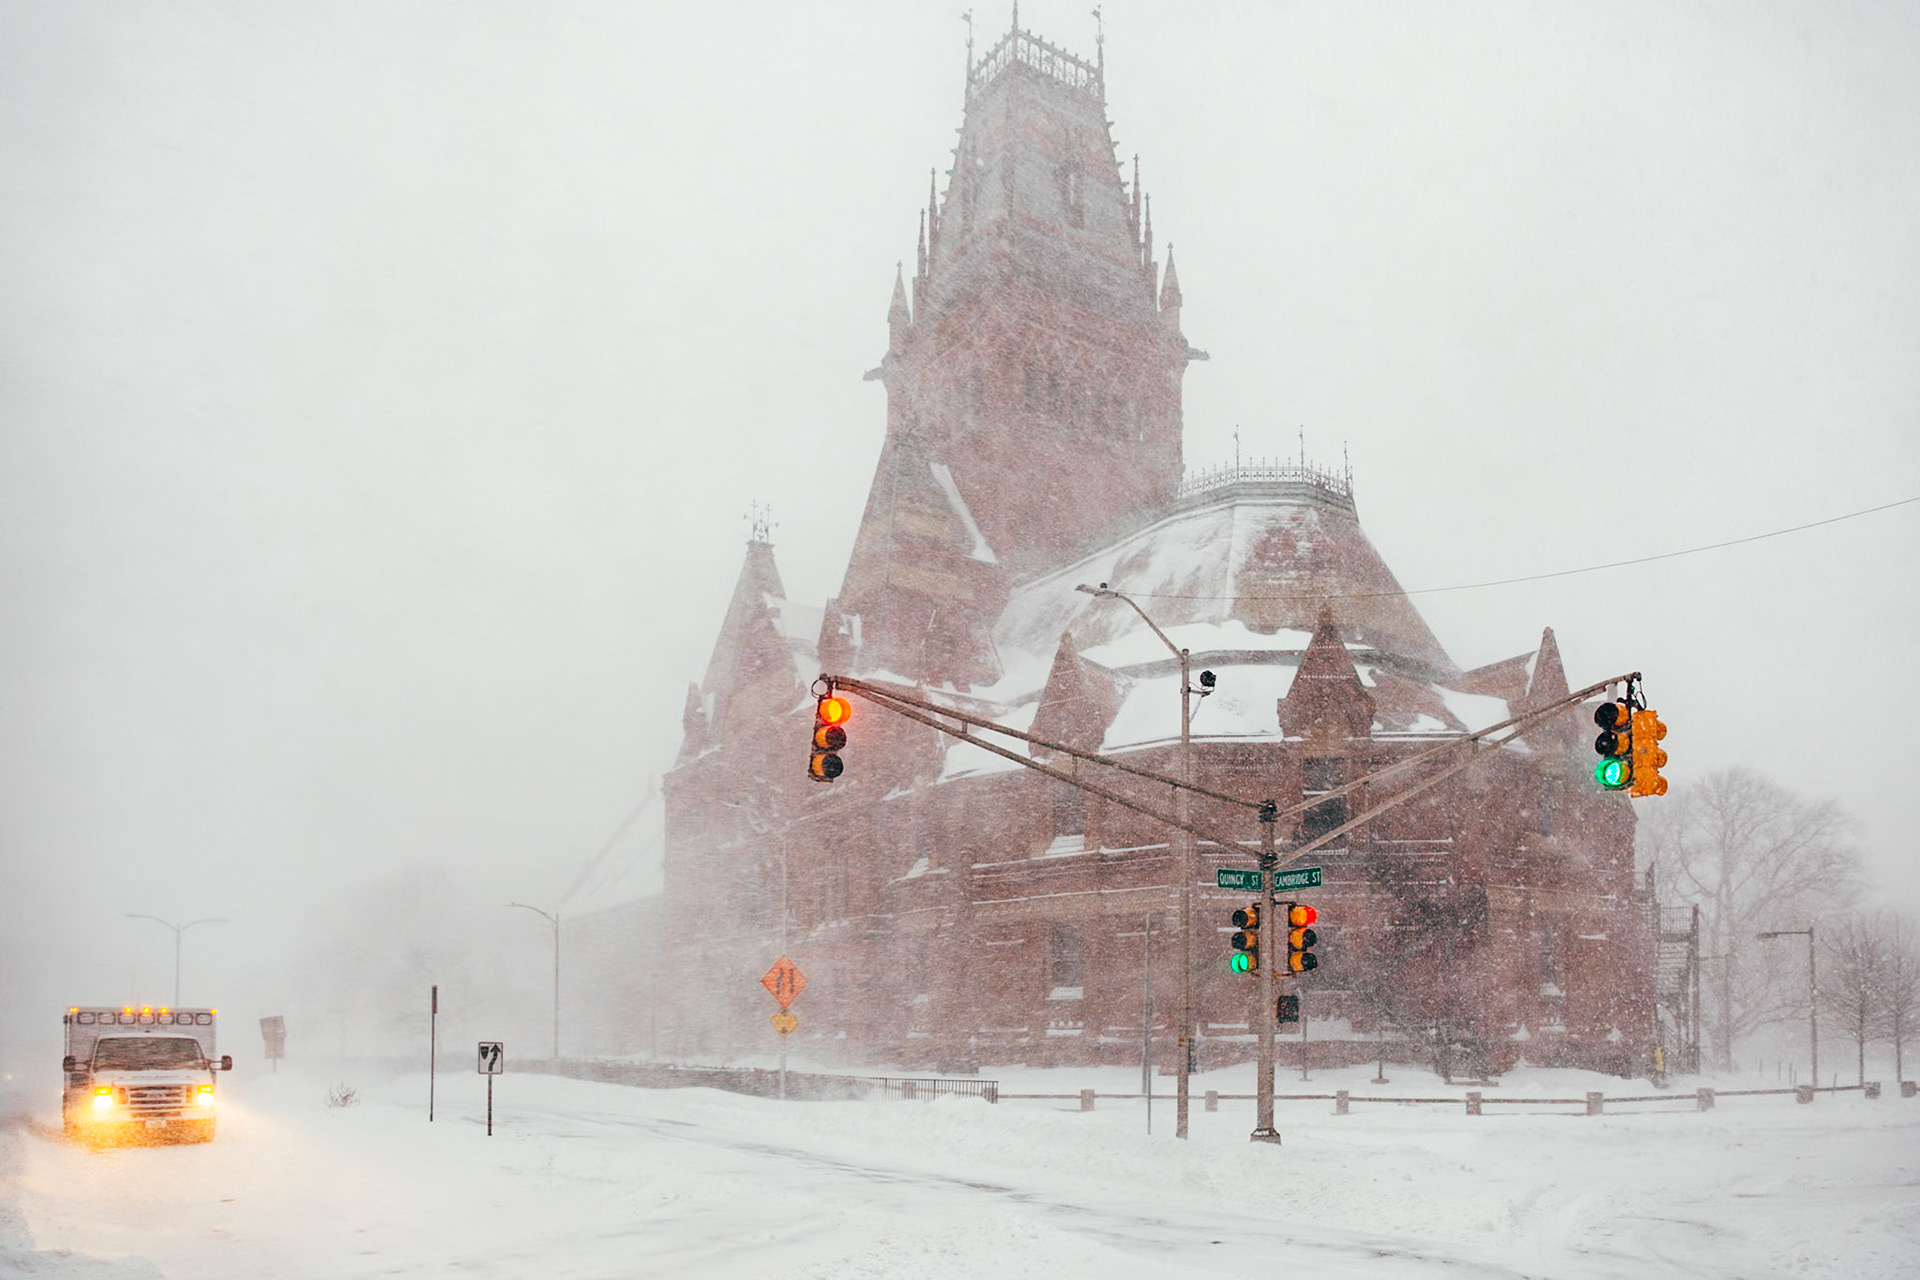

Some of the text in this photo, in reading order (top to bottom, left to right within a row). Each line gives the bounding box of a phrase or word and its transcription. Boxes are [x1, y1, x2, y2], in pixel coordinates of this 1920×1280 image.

[1219, 873, 1259, 886] QUINCY ST
[1275, 871, 1320, 887] CAMBRIDGE ST
